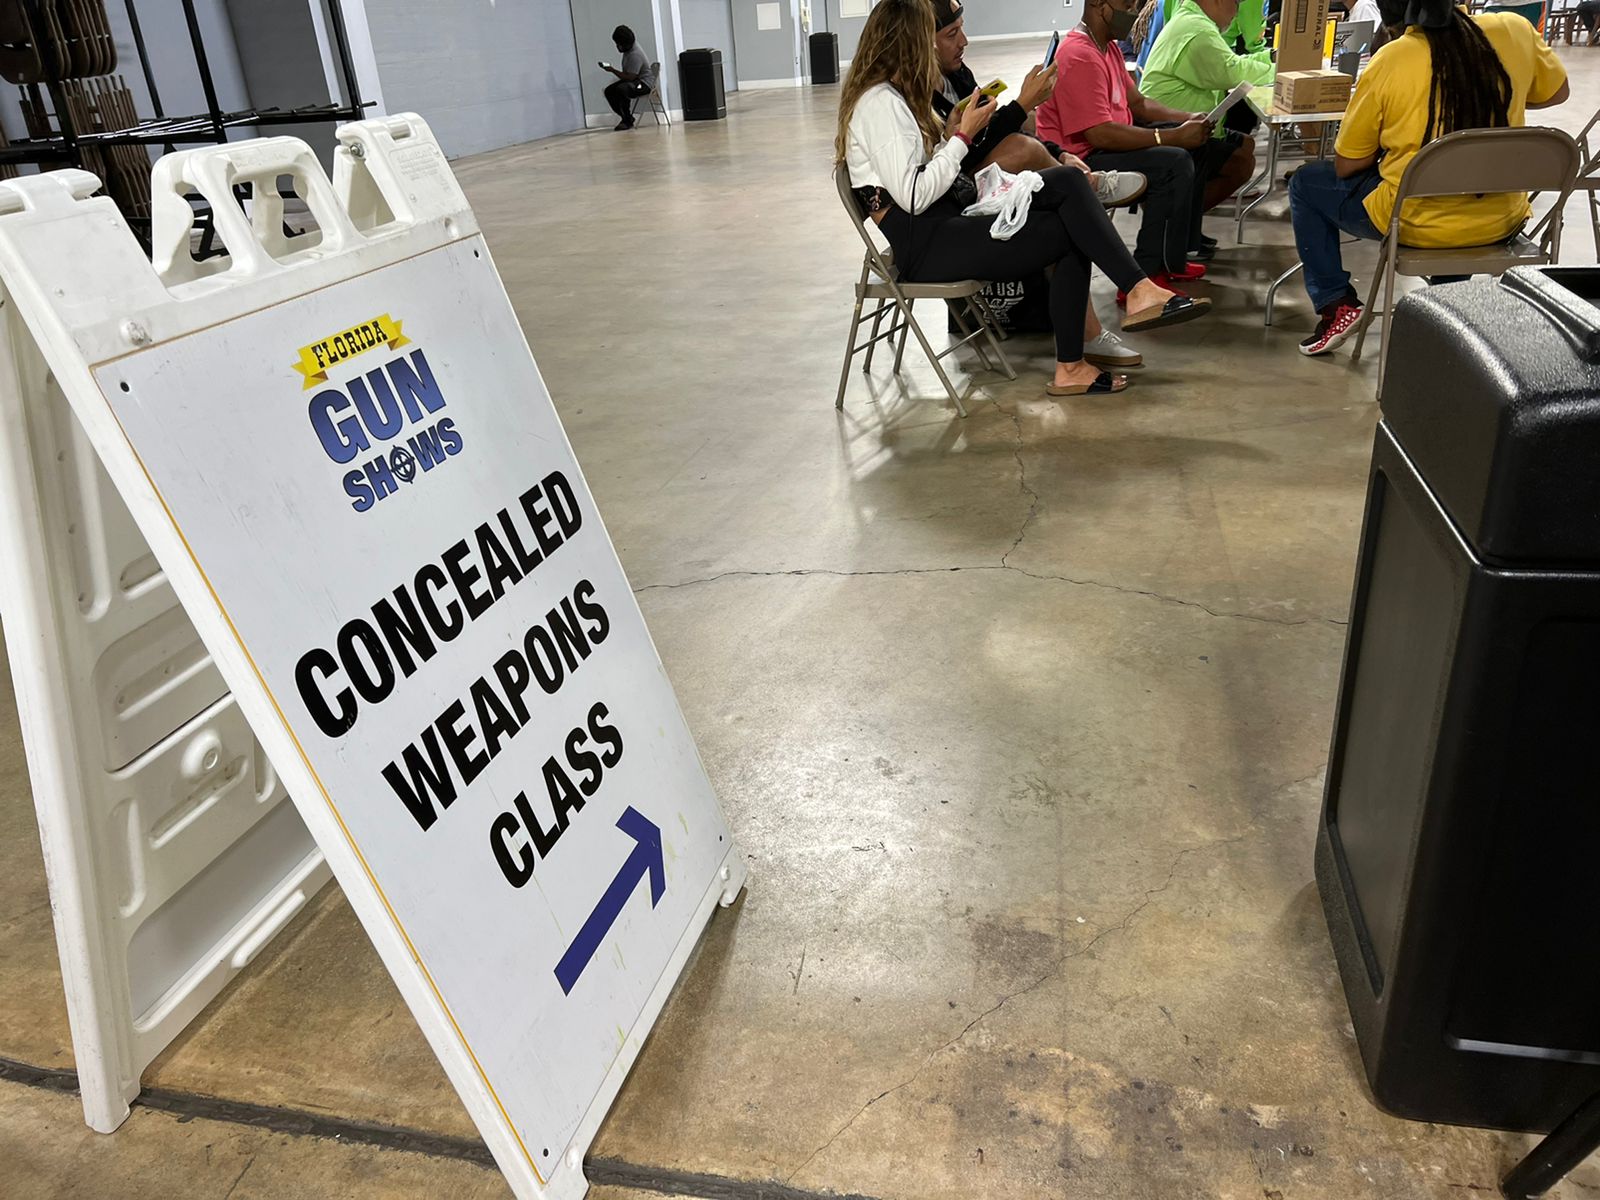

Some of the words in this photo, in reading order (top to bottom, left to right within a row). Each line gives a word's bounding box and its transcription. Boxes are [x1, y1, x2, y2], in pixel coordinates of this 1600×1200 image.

[311, 320, 388, 369] FLORIDA
[997, 281, 1024, 296] USA
[308, 348, 447, 464] GUN
[342, 417, 463, 513] SHOWS
[294, 470, 582, 738] CONCEALED
[381, 579, 610, 832] WEAPONS
[489, 701, 624, 889] CLASS
